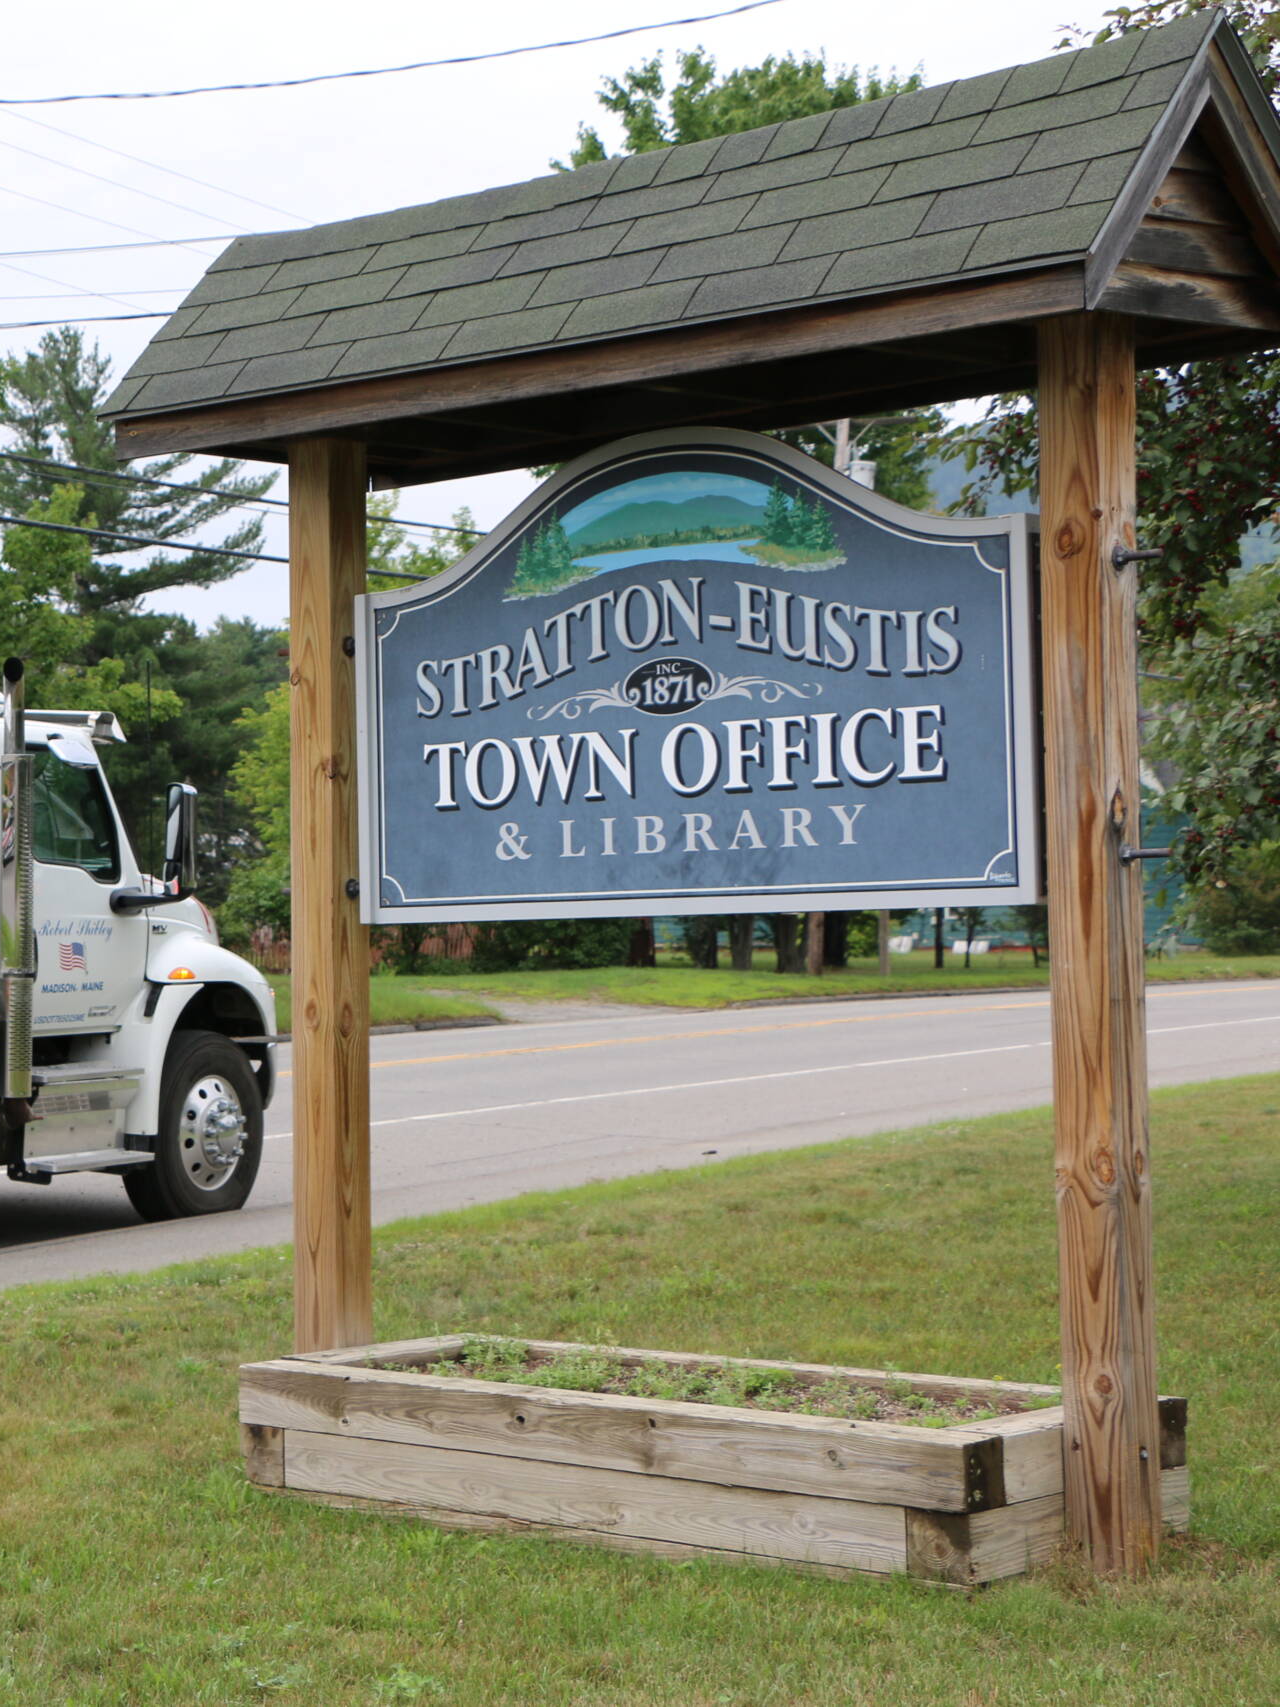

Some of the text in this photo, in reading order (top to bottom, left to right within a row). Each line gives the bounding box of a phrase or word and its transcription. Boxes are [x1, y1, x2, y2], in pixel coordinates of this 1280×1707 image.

[416, 577, 961, 718] STRATTON-EUSTIS
[655, 662, 681, 675] INC
[641, 674, 696, 706] 1871
[423, 705, 949, 811] TOWN OFFICE
[495, 803, 868, 862] & LIBRARY
[38, 920, 74, 936] Robert
[81, 981, 104, 992] MAINE
